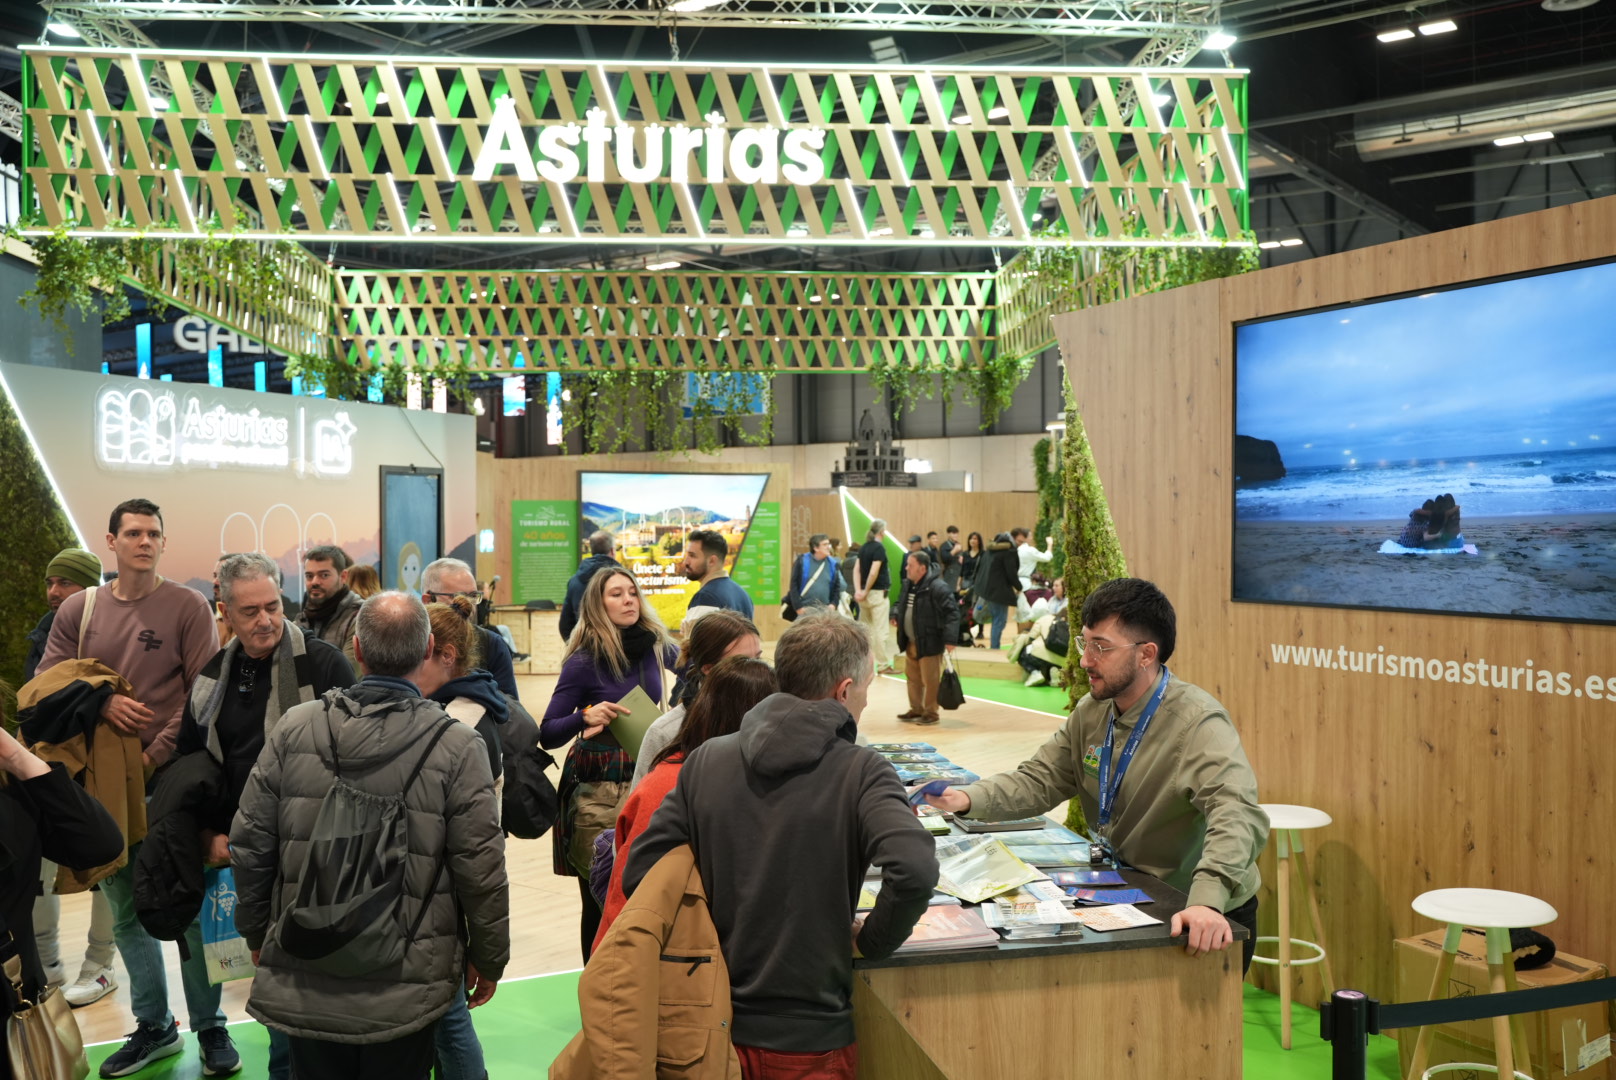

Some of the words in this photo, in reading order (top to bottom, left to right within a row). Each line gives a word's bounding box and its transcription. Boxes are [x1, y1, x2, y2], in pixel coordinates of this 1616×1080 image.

[472, 94, 825, 185] Asturias
[182, 397, 288, 445] Asturias
[633, 561, 663, 574] Únete
[665, 562, 676, 574] al
[1270, 643, 1616, 702] www.turismoasturias.es
